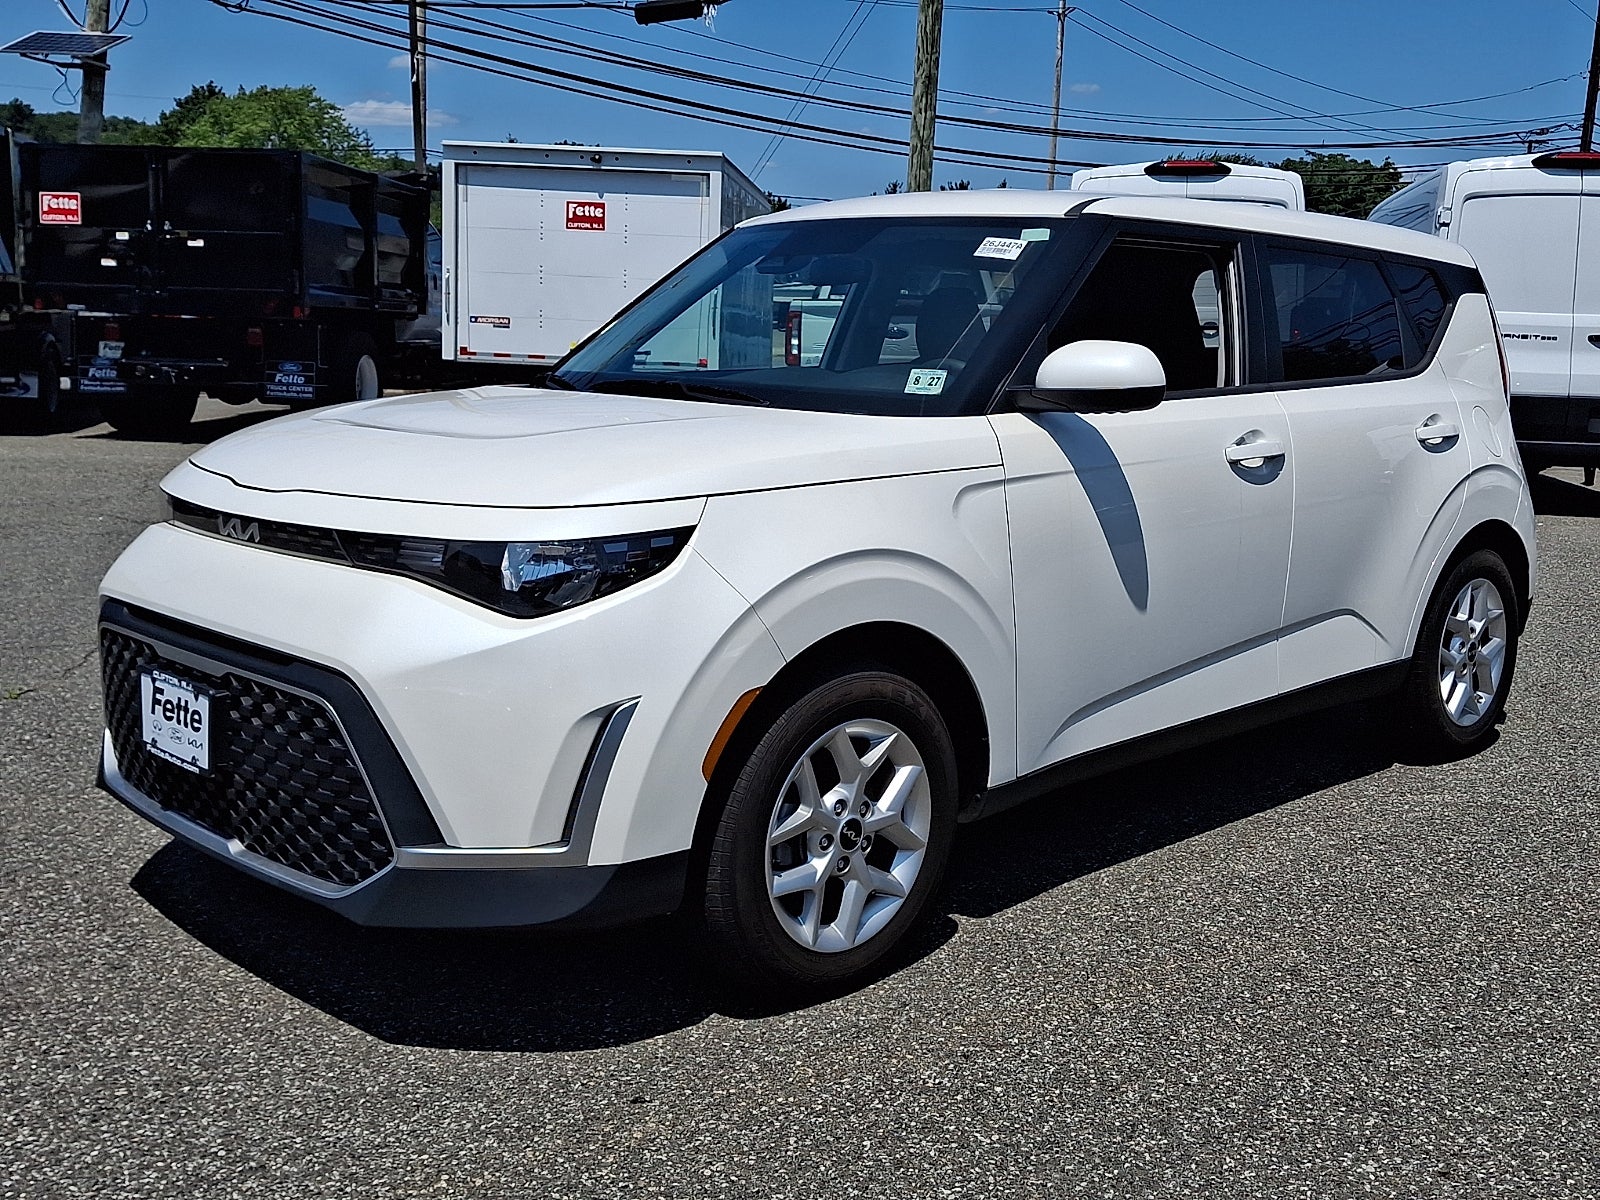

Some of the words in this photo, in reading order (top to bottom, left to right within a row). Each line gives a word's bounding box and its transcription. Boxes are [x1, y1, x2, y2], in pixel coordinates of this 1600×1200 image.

[43, 195, 77, 211] Fette
[569, 203, 603, 218] Fette
[983, 240, 1023, 249] 26J447A
[275, 373, 305, 384] Fette
[913, 376, 921, 385] 8
[928, 376, 942, 386] 27
[217, 514, 260, 543] KIA
[151, 683, 203, 733] Fette
